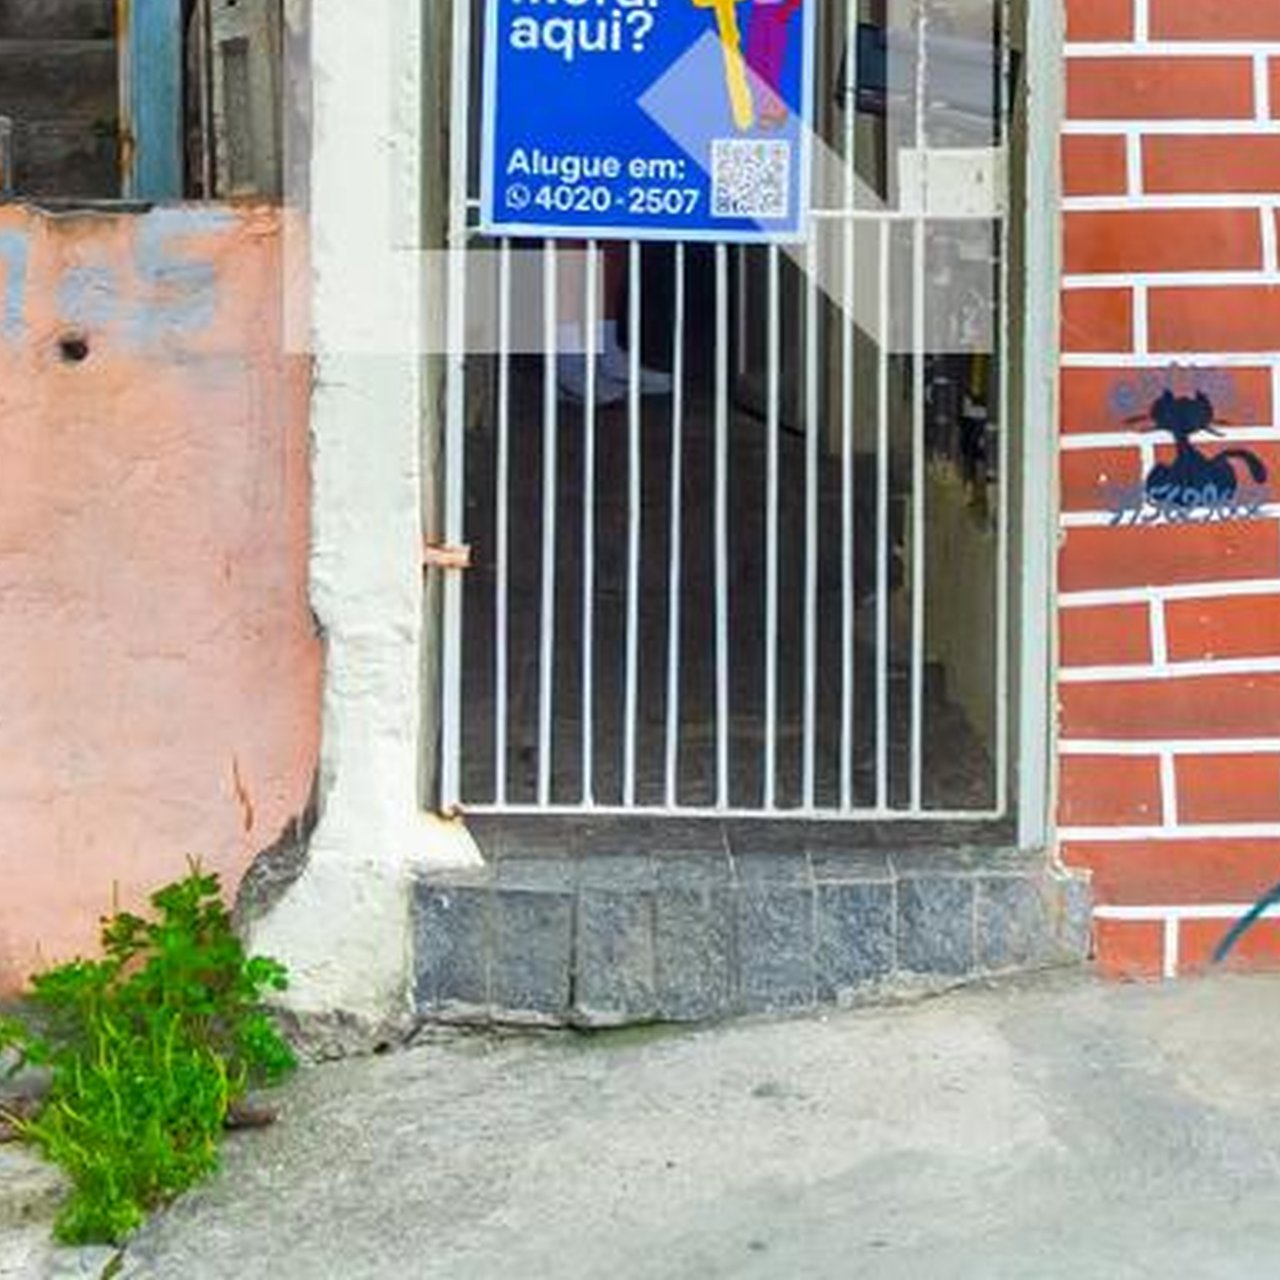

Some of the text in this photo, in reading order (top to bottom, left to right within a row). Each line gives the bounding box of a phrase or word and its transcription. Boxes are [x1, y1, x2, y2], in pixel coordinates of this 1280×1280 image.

[509, 9, 654, 62] aqui?
[506, 147, 686, 184] Alugue em:
